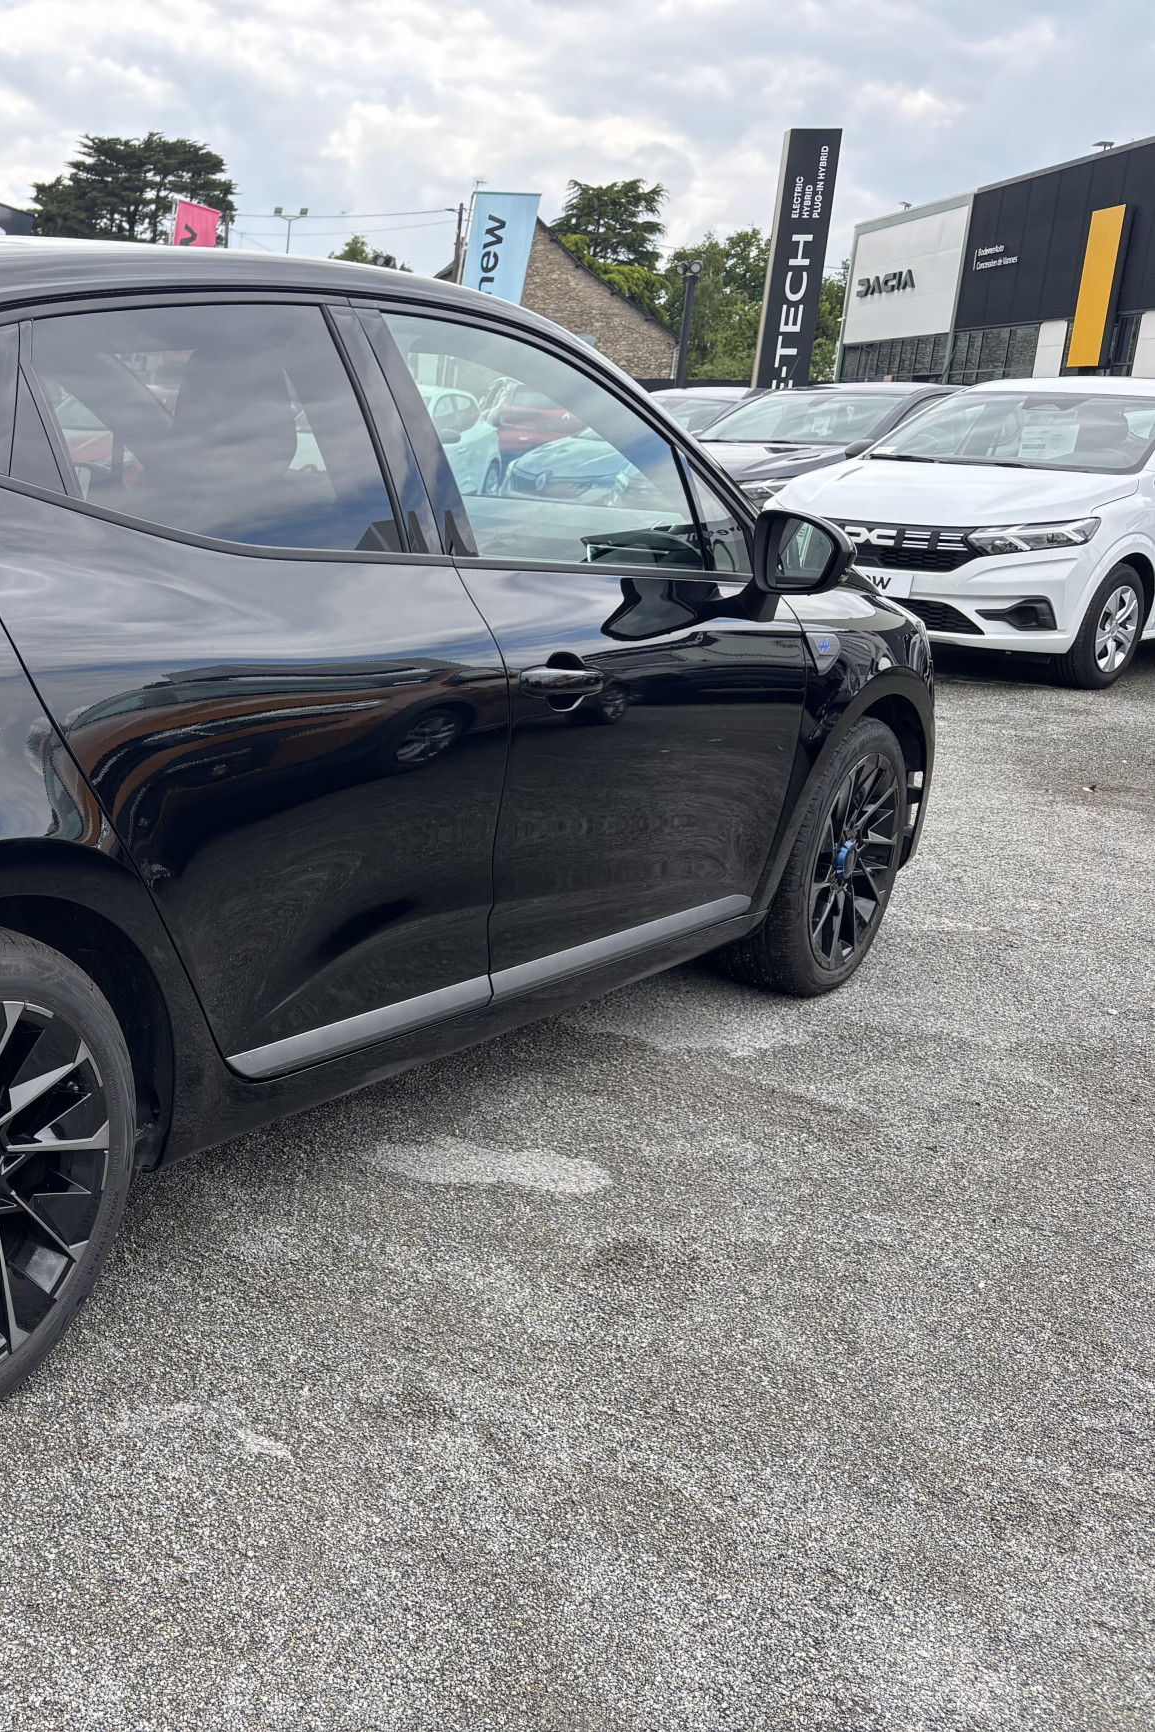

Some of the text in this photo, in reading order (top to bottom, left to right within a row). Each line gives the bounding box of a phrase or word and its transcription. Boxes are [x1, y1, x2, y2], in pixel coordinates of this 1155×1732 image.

[791, 176, 804, 219] ELECTRIC
[802, 184, 813, 219] HYBRID
[812, 145, 830, 219] PLUG-IN HYBRID
[856, 269, 916, 298] DACIA
